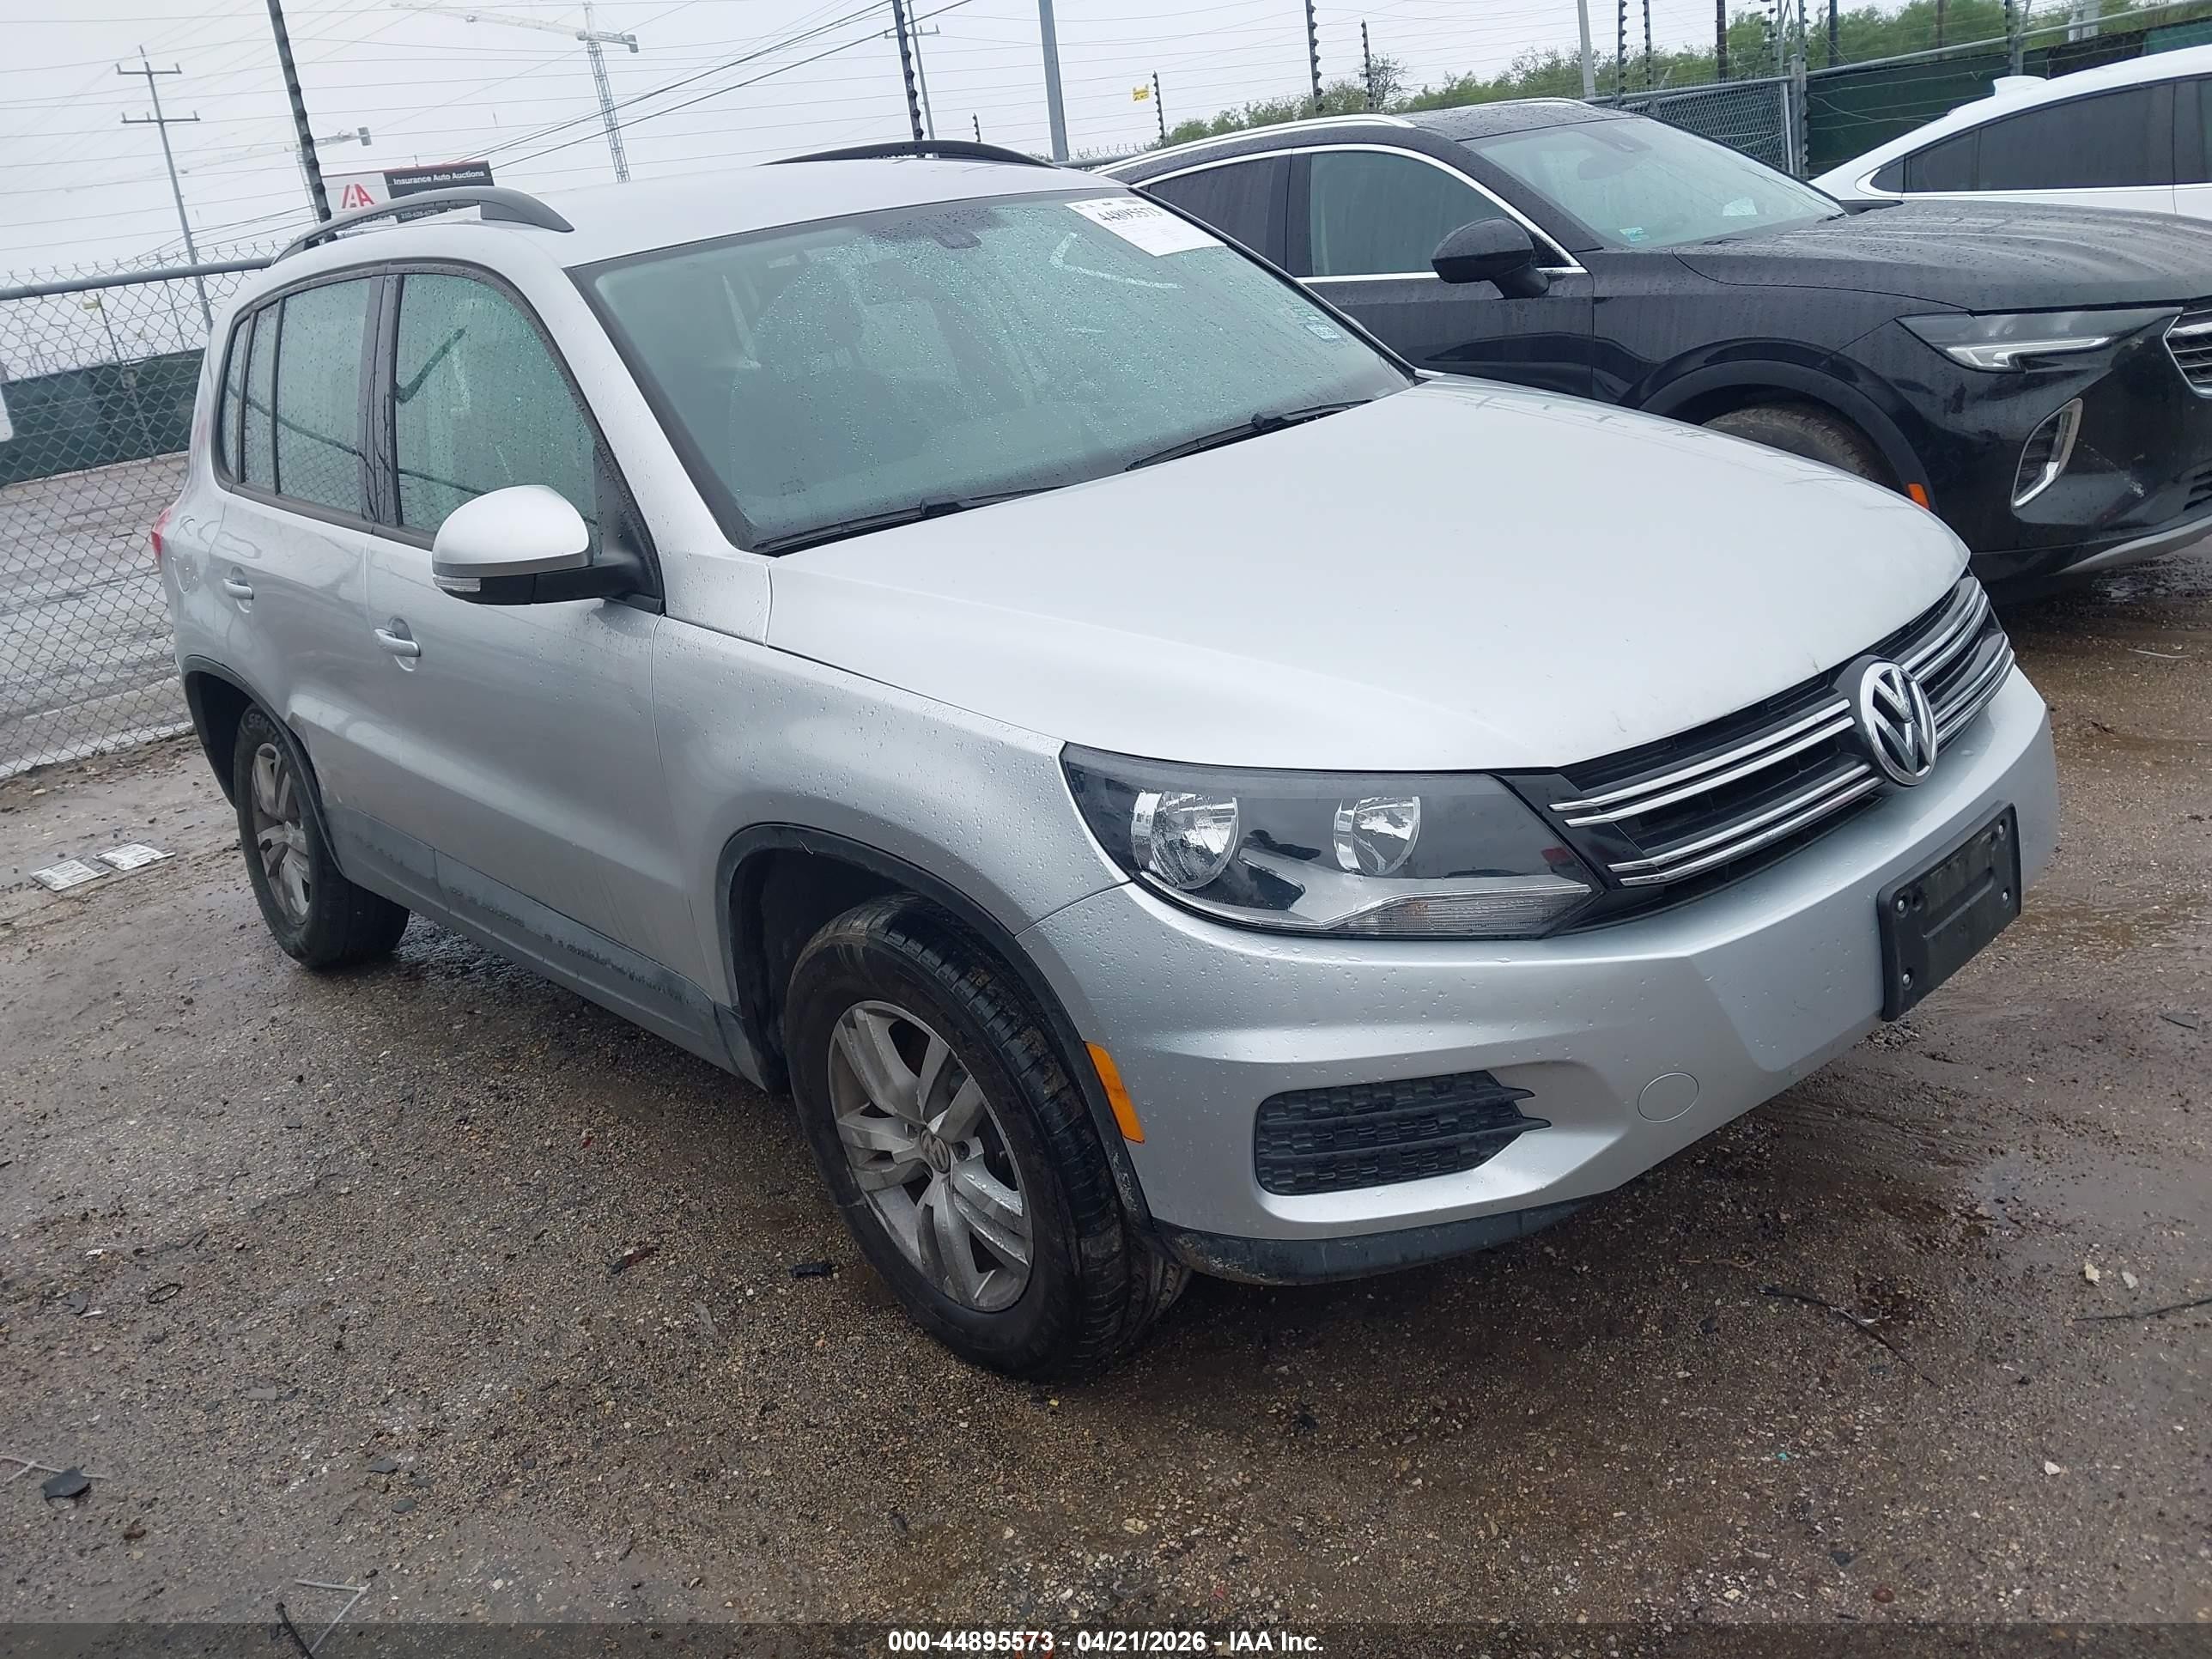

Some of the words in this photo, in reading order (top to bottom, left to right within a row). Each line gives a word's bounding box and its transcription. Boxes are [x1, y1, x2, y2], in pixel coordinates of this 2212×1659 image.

[393, 176, 431, 185] Insurance
[452, 170, 484, 179] Auctions
[1097, 207, 1163, 222] 44895573
[1860, 662, 1937, 786] VW
